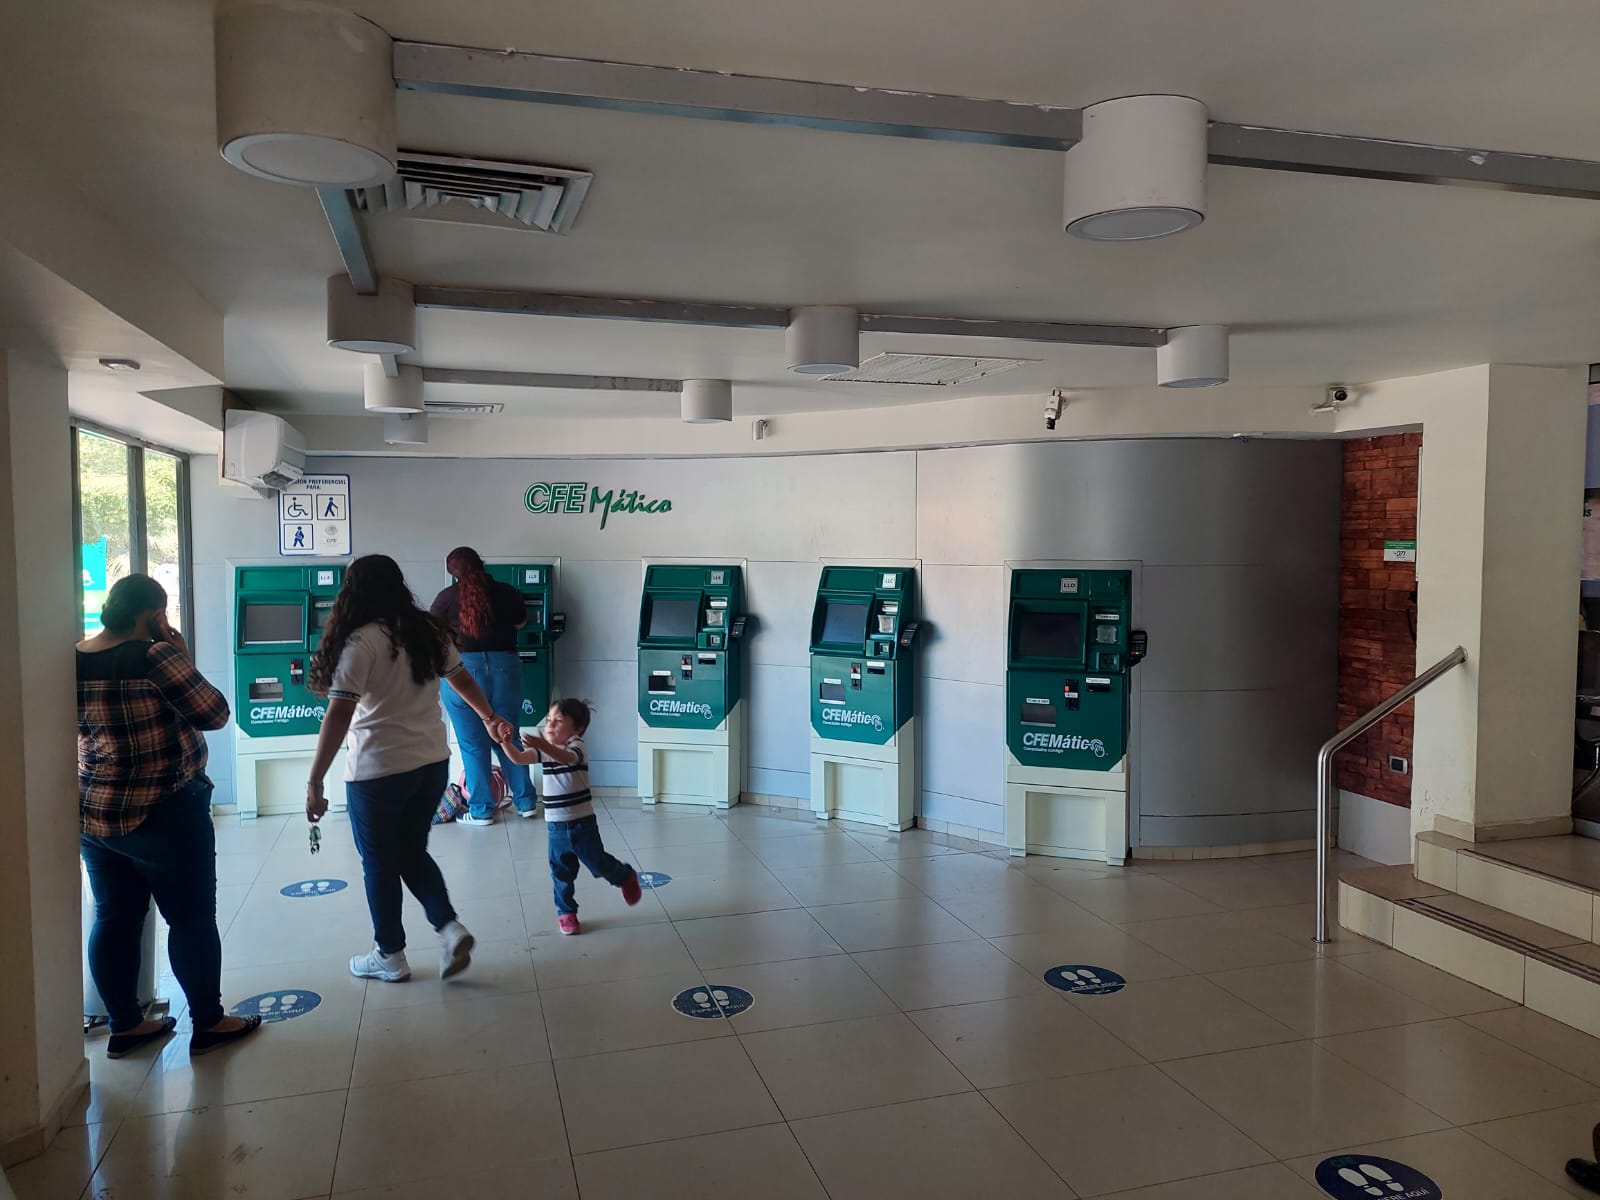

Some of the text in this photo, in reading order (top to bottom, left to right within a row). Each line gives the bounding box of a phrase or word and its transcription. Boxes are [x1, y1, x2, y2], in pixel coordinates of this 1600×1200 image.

[524, 482, 672, 530] CFE Mático
[1405, 1187, 1430, 1199] AQUÍ
